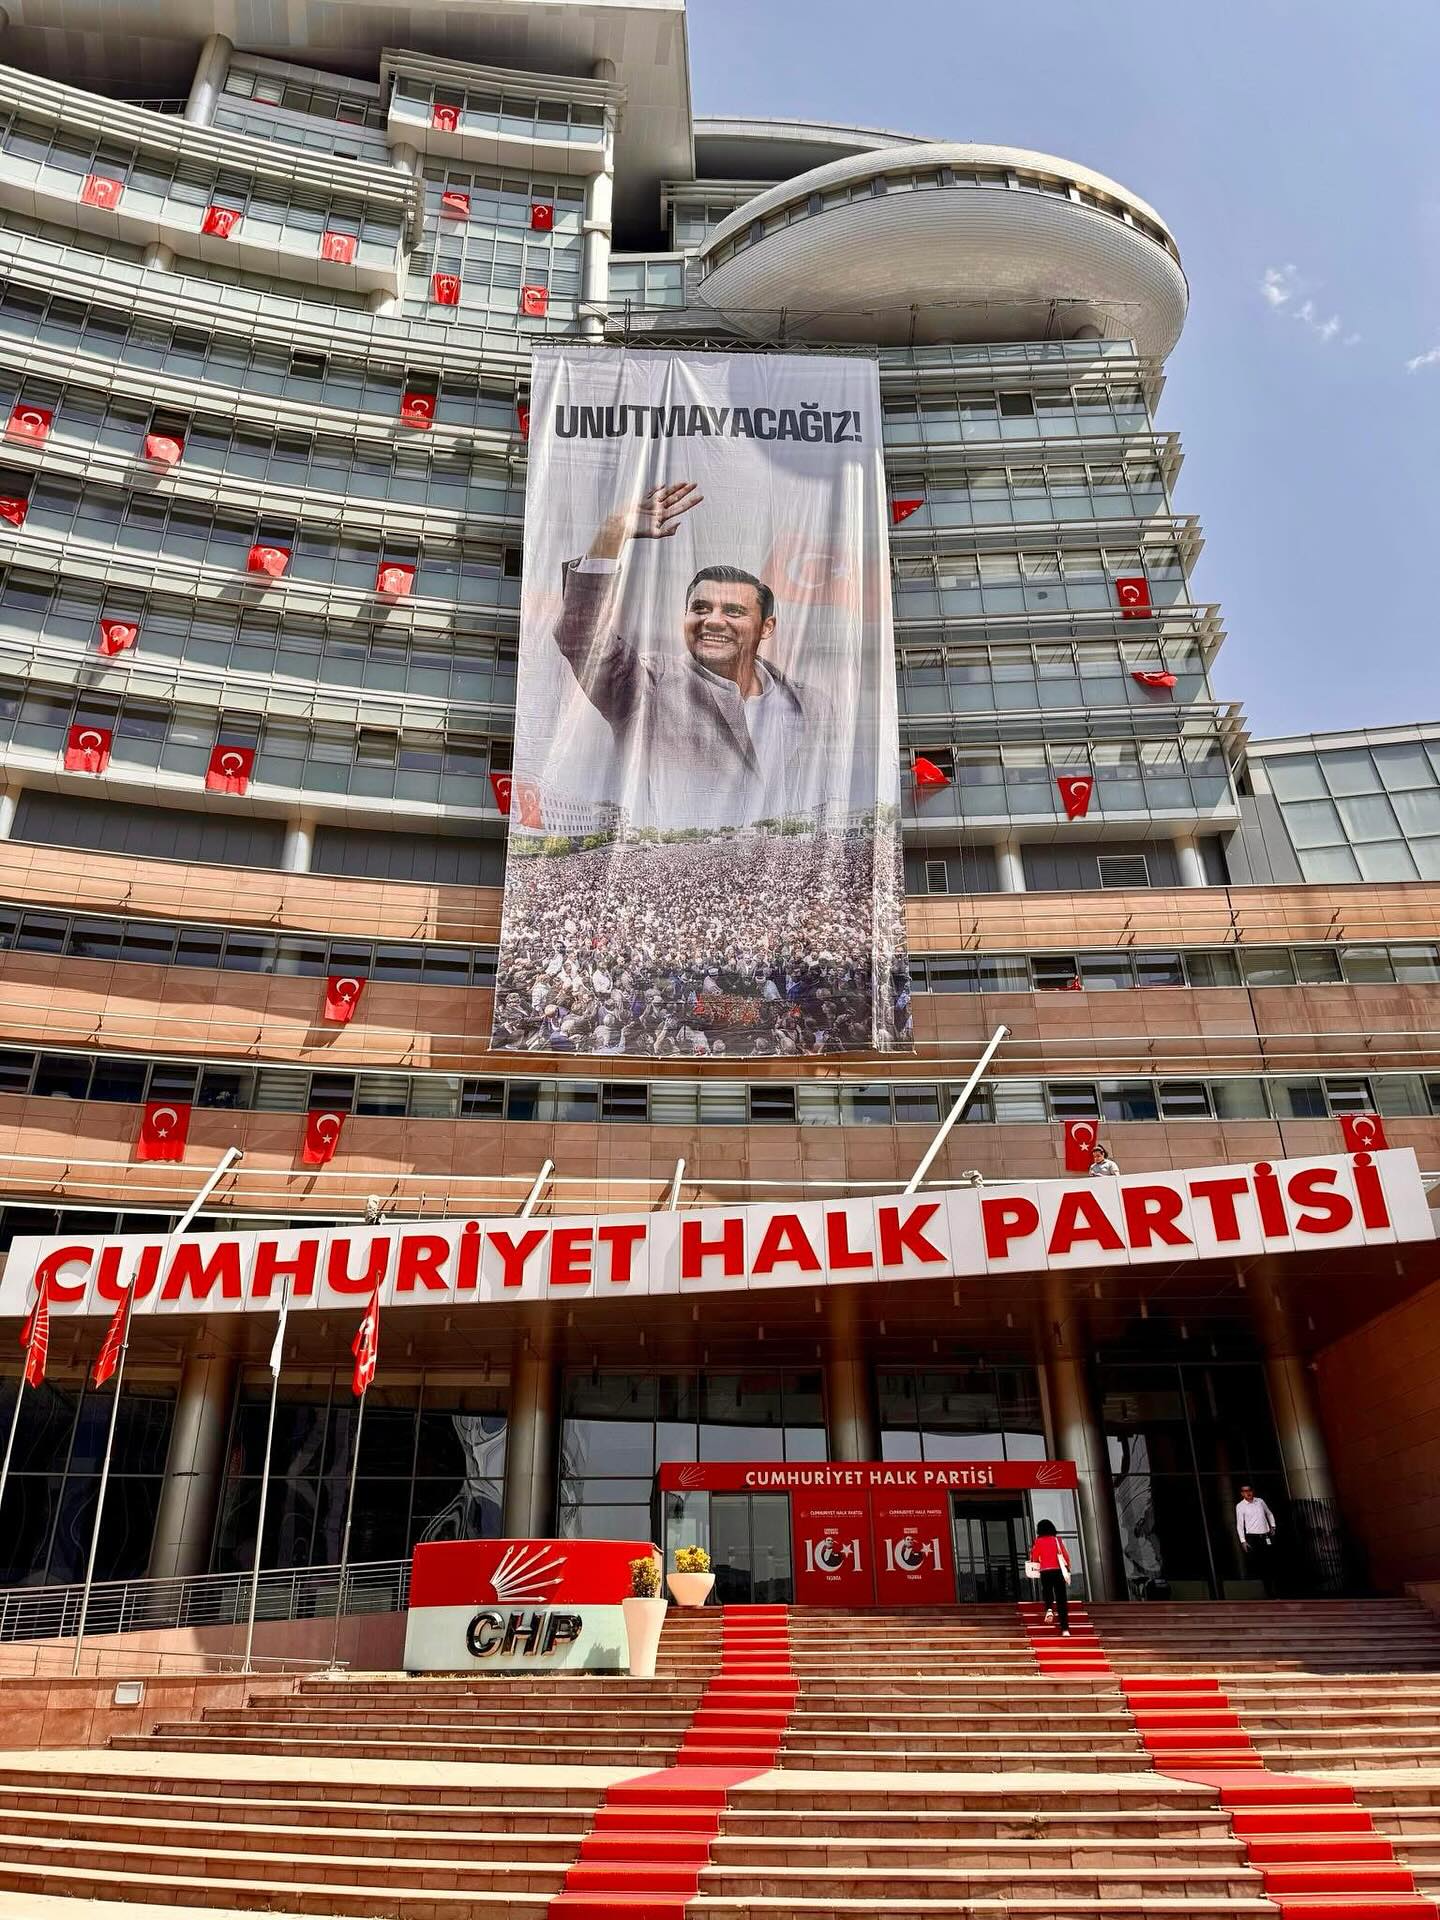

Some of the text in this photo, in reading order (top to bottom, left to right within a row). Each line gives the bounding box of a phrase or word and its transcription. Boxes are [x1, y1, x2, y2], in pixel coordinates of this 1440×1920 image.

[555, 401, 864, 443] UNUTMAYACAĞIZ!
[34, 1152, 1390, 1301] CUMHURİYET HALK PARTİSİ
[745, 1466, 994, 1486] CUMHURİYET HALK PARTİSİ
[466, 1611, 583, 1658] CHP
